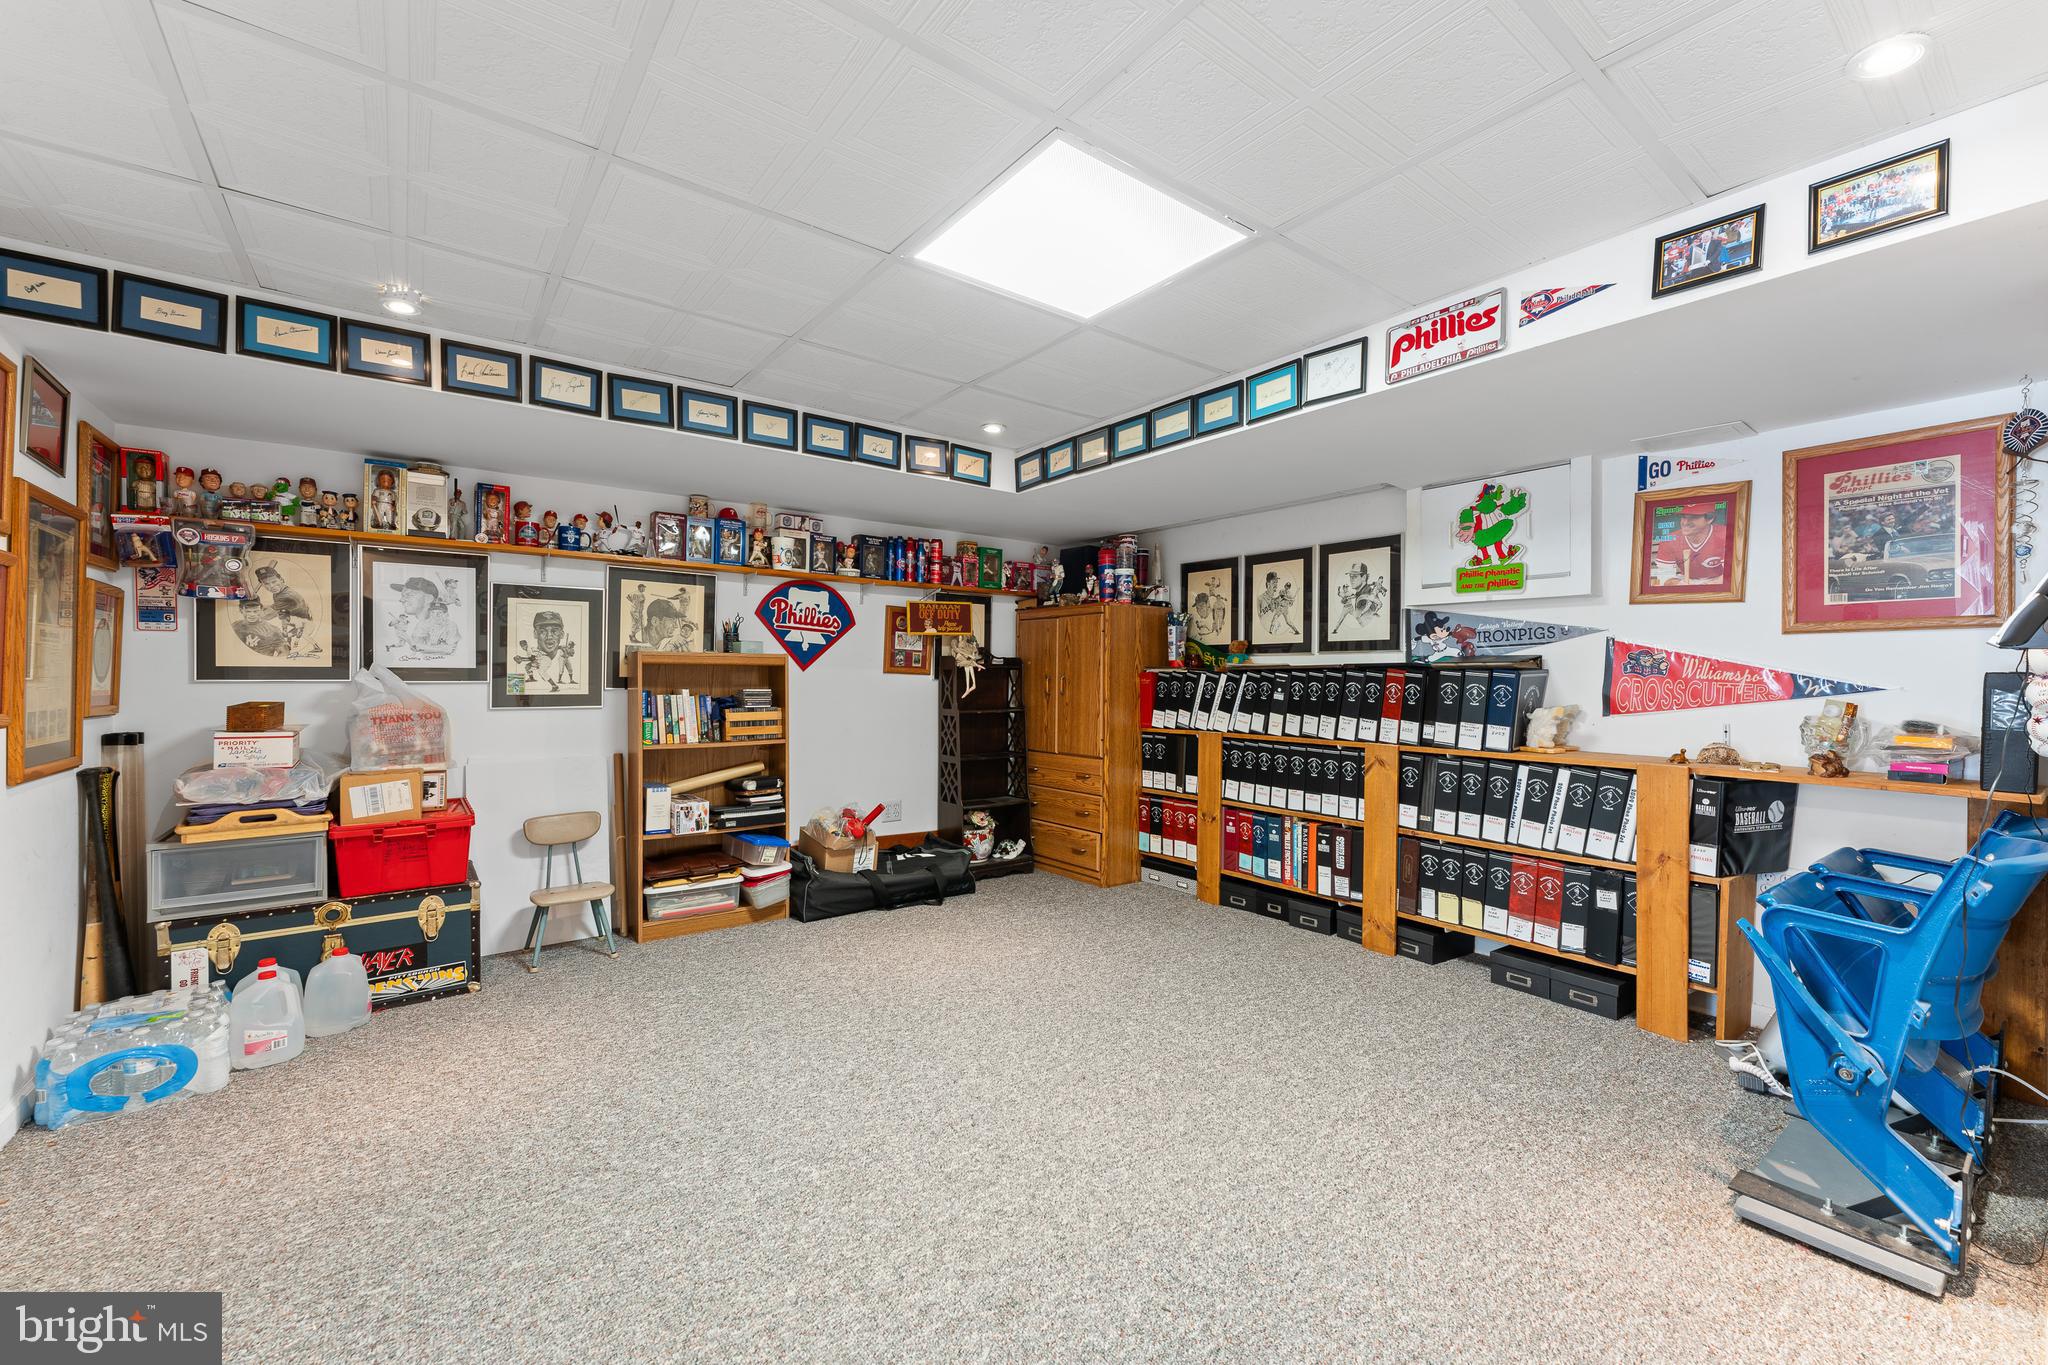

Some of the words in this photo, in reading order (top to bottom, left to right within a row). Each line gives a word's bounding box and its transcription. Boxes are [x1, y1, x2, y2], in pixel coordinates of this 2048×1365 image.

[1556, 286, 1596, 303] Philadelphia
[1400, 353, 1462, 379] PHILADELPHIA
[1466, 341, 1498, 358] Phillies
[1649, 460, 1672, 479] GO
[1676, 460, 1716, 471] Phillies
[1829, 471, 1912, 491] Phillies
[1836, 485, 1872, 495] Report
[1842, 496, 1876, 506] Special
[1877, 493, 1903, 503] Night
[1915, 489, 1932, 497] the
[1932, 487, 1949, 495] Vet
[204, 533, 229, 542] HOSKINS
[231, 534, 239, 542] 17
[1459, 569, 1485, 581] Phillie
[1485, 567, 1520, 579] Phanatic
[1487, 578, 1519, 591] Phillies
[769, 597, 841, 630] Phillies
[919, 609, 934, 619] OFF
[937, 609, 961, 620] DUTY
[1477, 626, 1556, 643] IRONPIGS
[1615, 677, 1783, 713] CROSSCUTTERS
[370, 712, 415, 725] THANK
[417, 711, 441, 720] YOU
[1695, 804, 1716, 812] BASEBALL
[1735, 811, 1766, 826] BASEBALL
[361, 947, 414, 976] LAYER
[389, 967, 441, 980] PITTSBURGH
